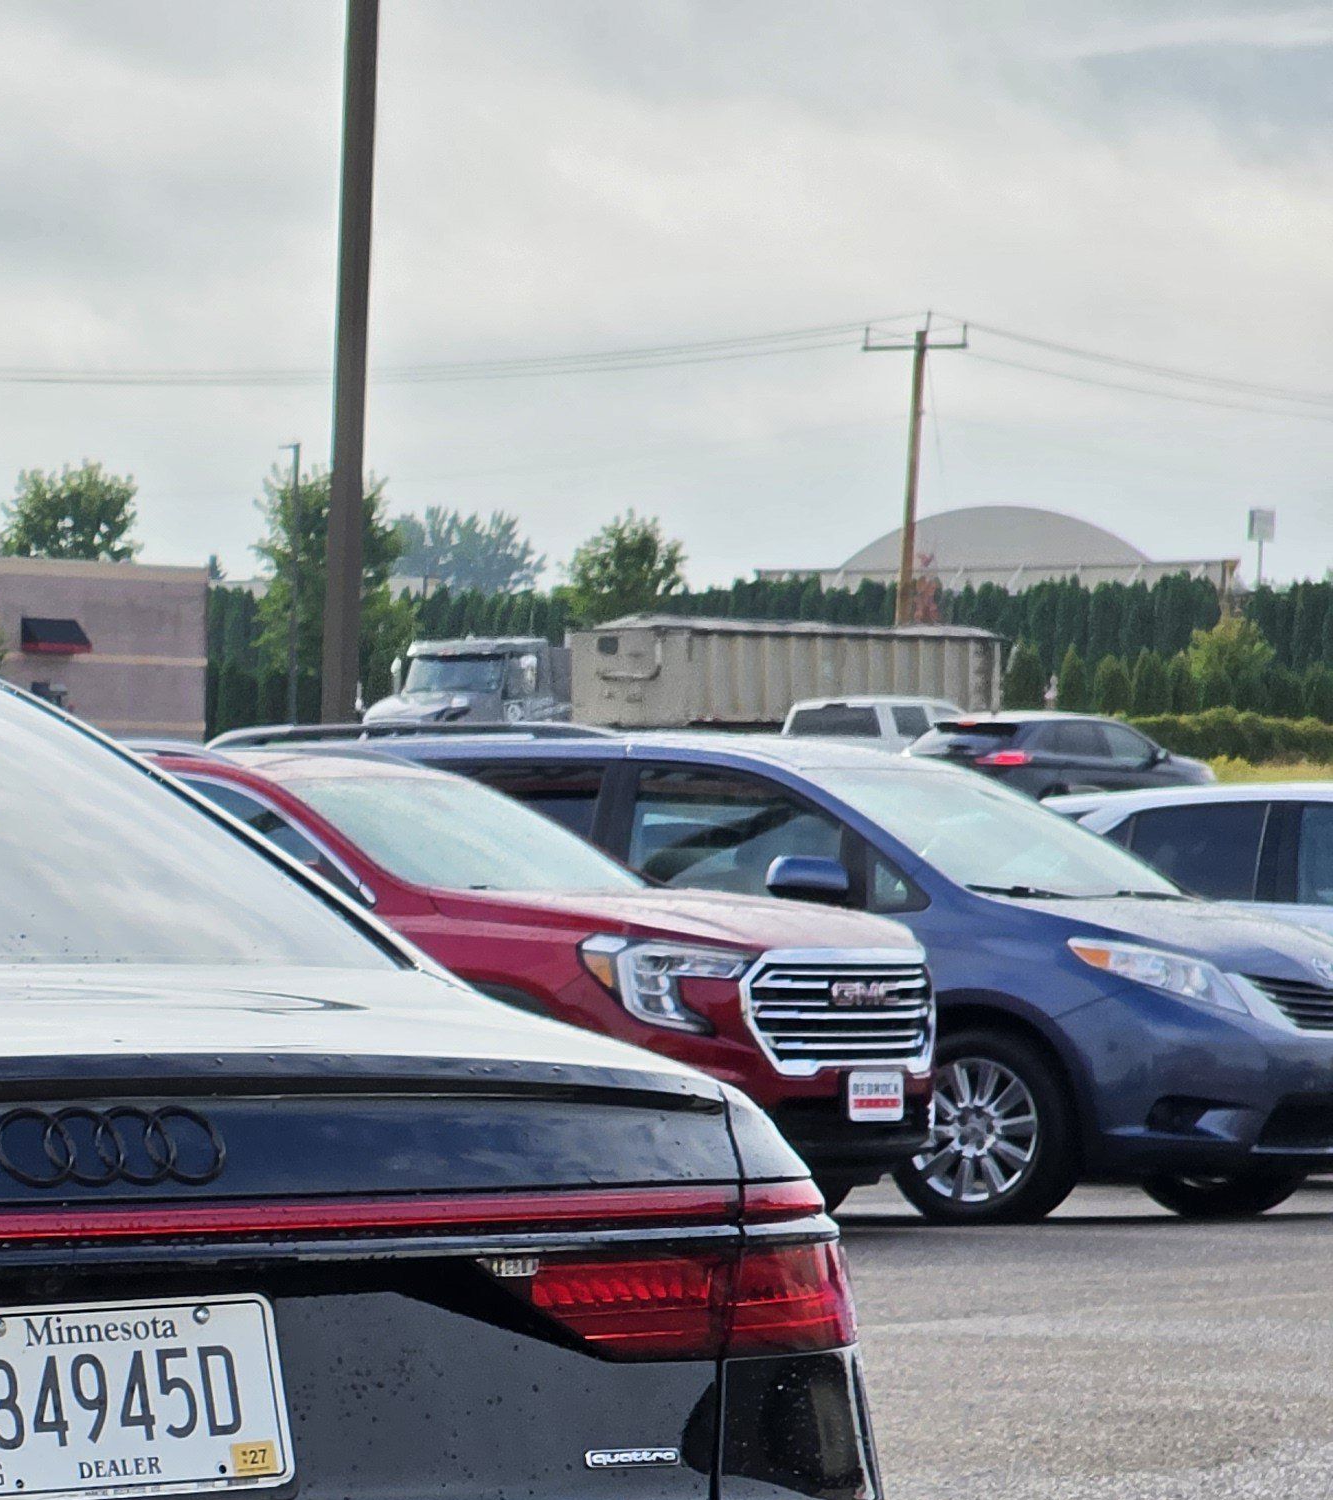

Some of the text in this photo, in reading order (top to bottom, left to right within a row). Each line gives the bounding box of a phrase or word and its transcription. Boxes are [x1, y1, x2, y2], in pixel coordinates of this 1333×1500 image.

[831, 981, 900, 1006] GMC
[24, 1316, 178, 1347] Minnesota
[78, 1456, 163, 1480] DEALER
[249, 1449, 267, 1464] 27
[592, 1450, 676, 1466] quattro
